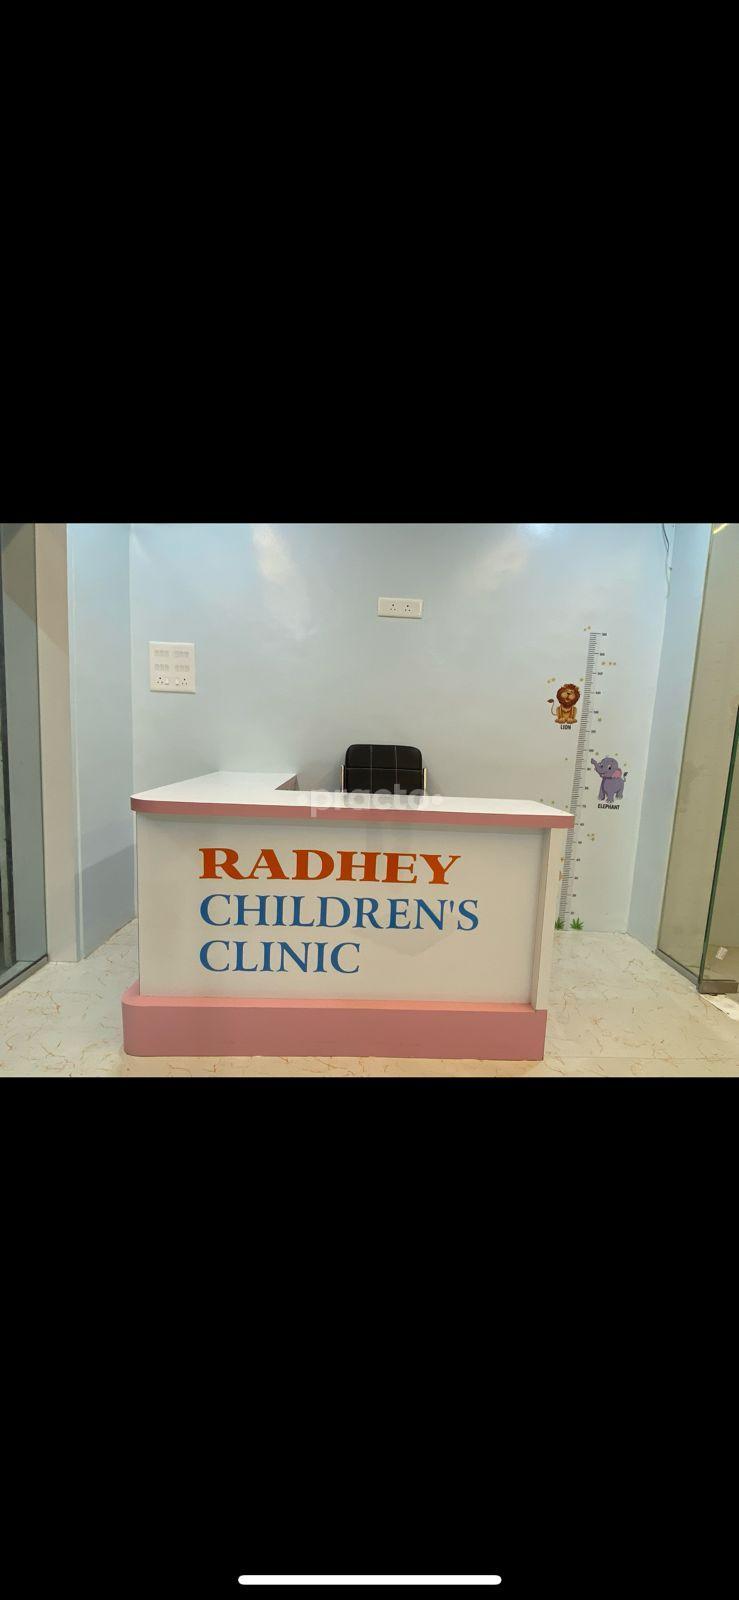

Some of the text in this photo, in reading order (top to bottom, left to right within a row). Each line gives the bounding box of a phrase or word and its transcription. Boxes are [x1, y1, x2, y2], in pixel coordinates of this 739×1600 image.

[199, 848, 461, 884] RADHEY
[200, 894, 479, 931] CHILDREN'S
[200, 940, 361, 973] CLINIC
